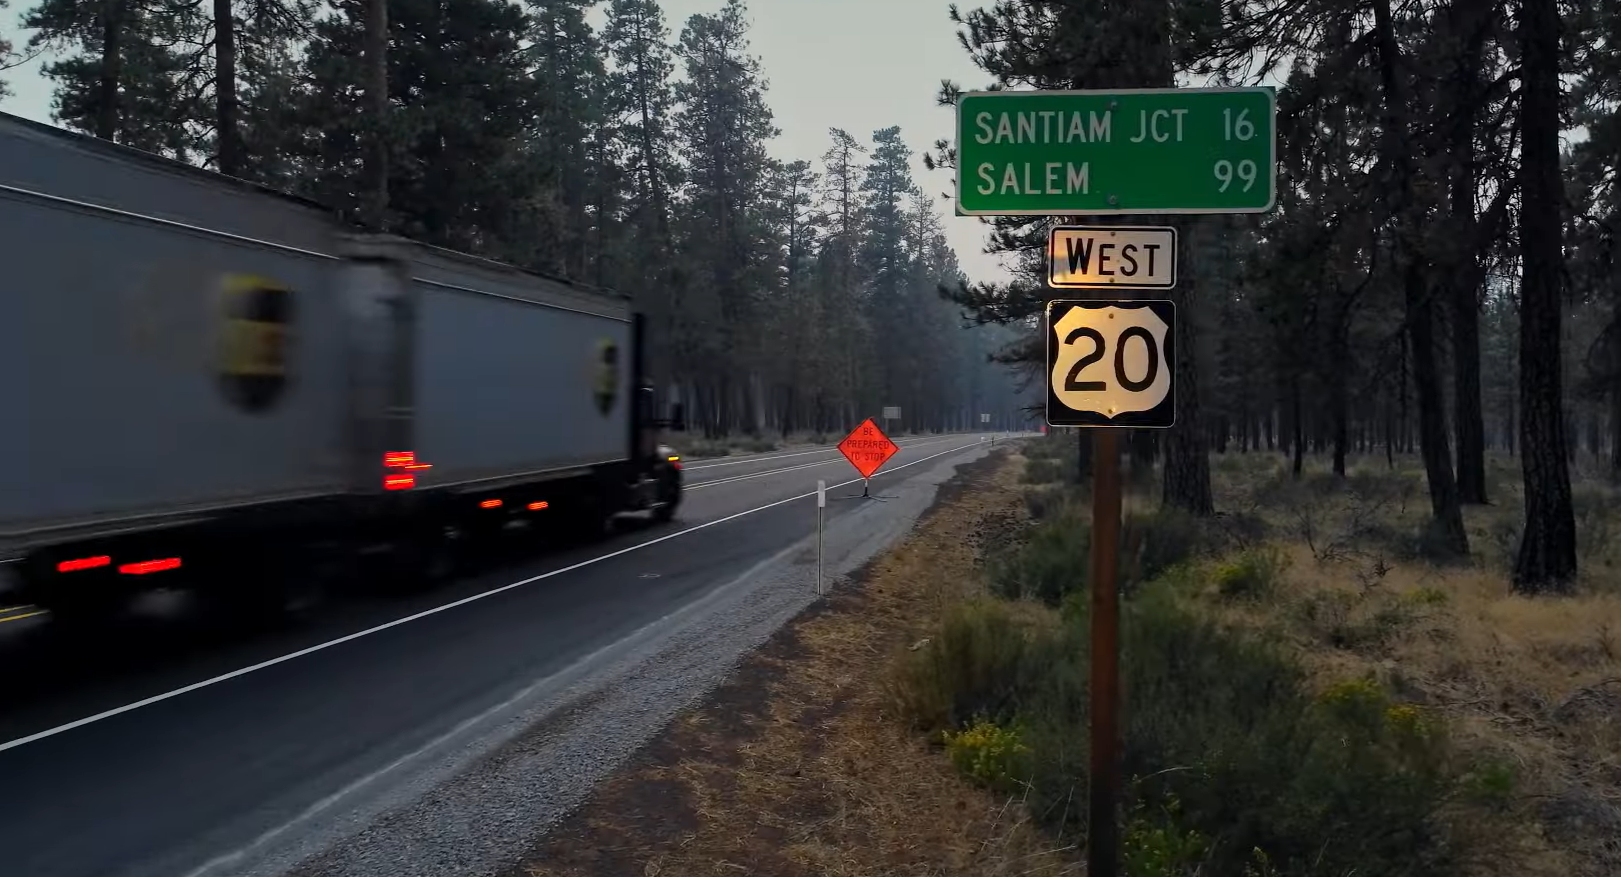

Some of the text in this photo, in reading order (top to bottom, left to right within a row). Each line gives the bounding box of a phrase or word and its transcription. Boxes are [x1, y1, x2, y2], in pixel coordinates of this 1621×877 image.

[974, 107, 1255, 145] SANTIAM JCT 16
[976, 158, 1258, 196] SALEM 99
[1065, 237, 1161, 277] WEST
[1063, 325, 1159, 393] 20
[846, 440, 890, 450] PREPARED
[863, 427, 874, 436] BE
[851, 451, 886, 462] TO STOP
